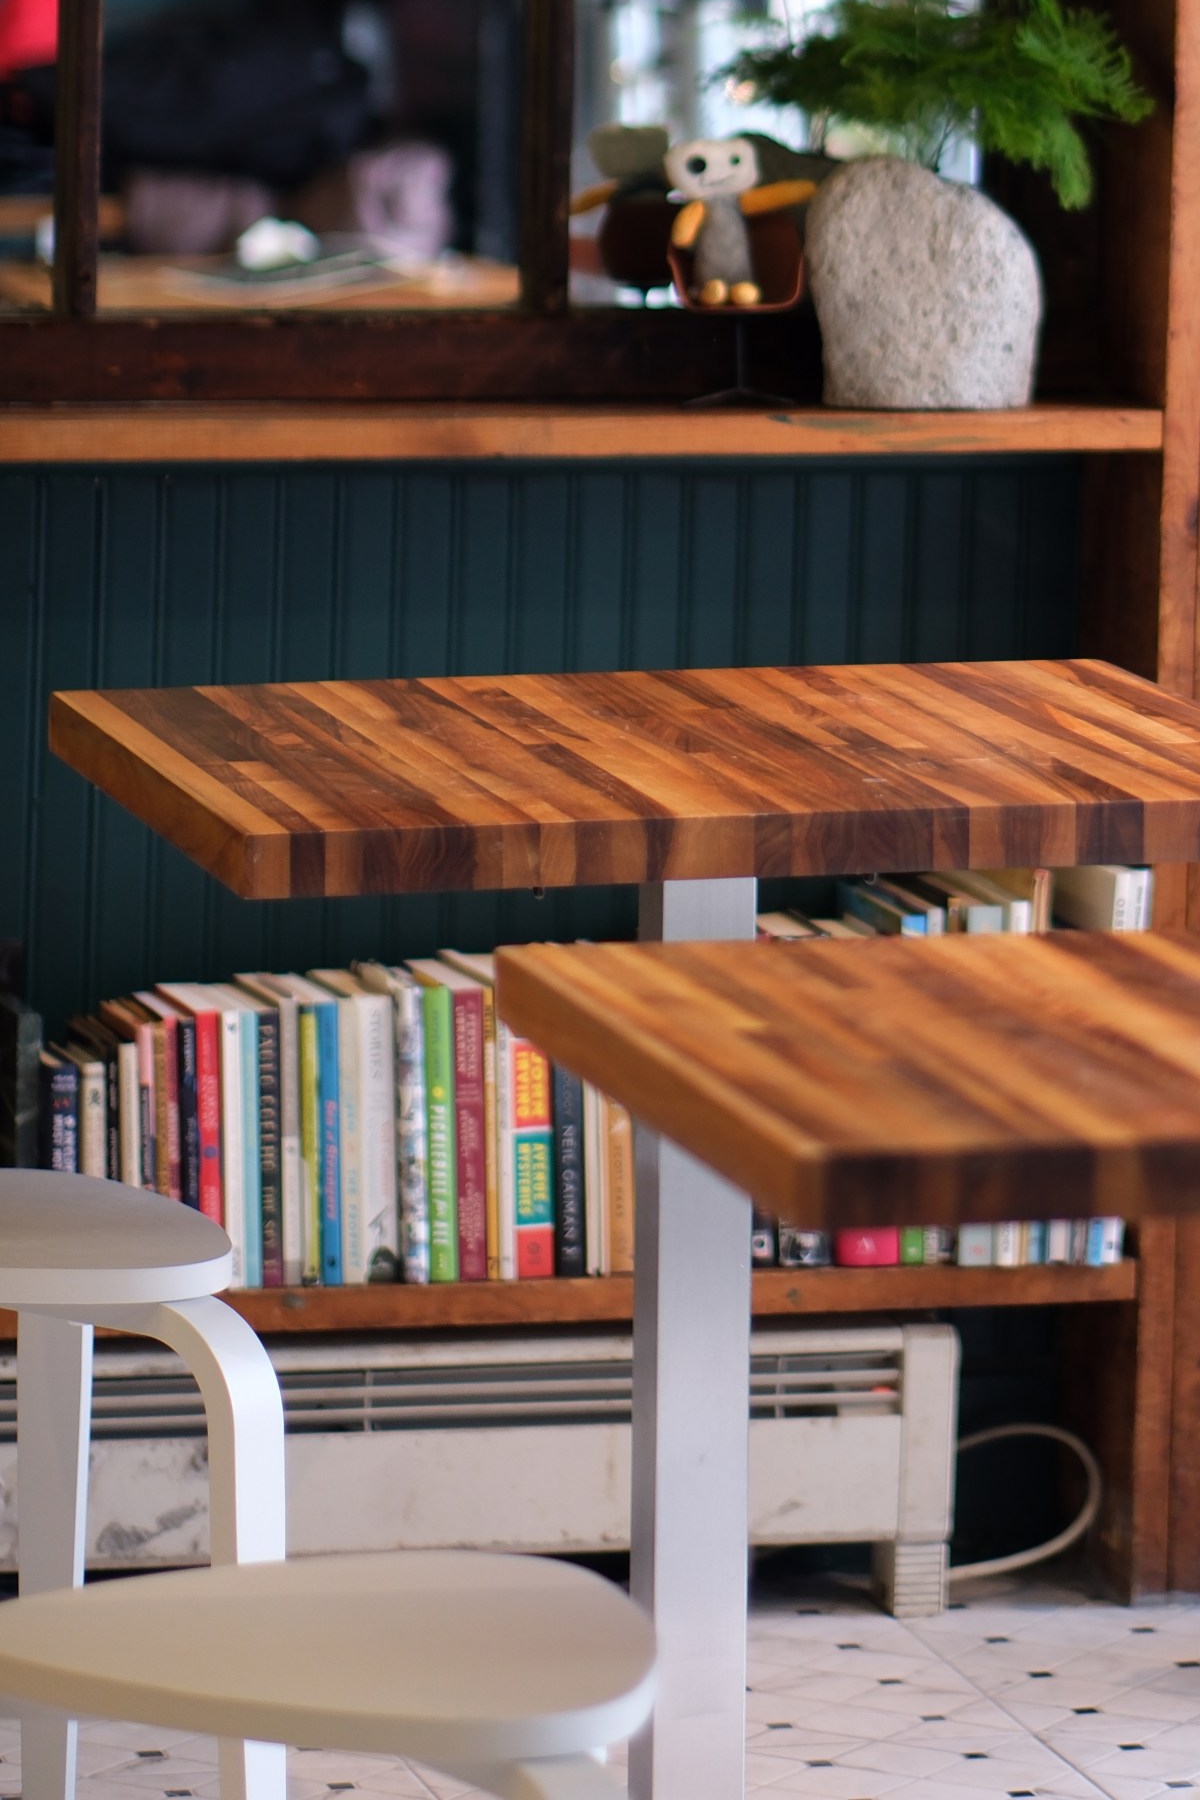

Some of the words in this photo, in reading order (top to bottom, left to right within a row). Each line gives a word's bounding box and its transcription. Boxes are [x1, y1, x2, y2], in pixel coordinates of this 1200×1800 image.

[257, 1024, 275, 1088] PAULO
[366, 1007, 383, 1080] STORIES
[453, 1005, 466, 1072] LIBRARIAN
[464, 1013, 477, 1078] PERSONAL
[323, 1098, 337, 1128] Sea
[513, 1050, 531, 1118] IRVING
[529, 1050, 545, 1118] JOHN
[258, 1094, 277, 1171] COELHO
[428, 1104, 447, 1194] PICKLEBALL
[458, 1109, 469, 1158] BENEDICT
[467, 1117, 478, 1148] MARIE
[559, 1123, 575, 1163] NEIL
[611, 1143, 624, 1183] SCOTT
[261, 1184, 275, 1214] THE
[323, 1143, 339, 1220] Strangers
[515, 1142, 532, 1217] MYSTERIES
[530, 1142, 548, 1202] AVENUE
[559, 1168, 577, 1239] GAIMAN
[612, 1185, 625, 1218] HAAS
[262, 1218, 276, 1249] SPY
[431, 1219, 449, 1246] ALL
[463, 1181, 474, 1250] CHRISTOPHER
